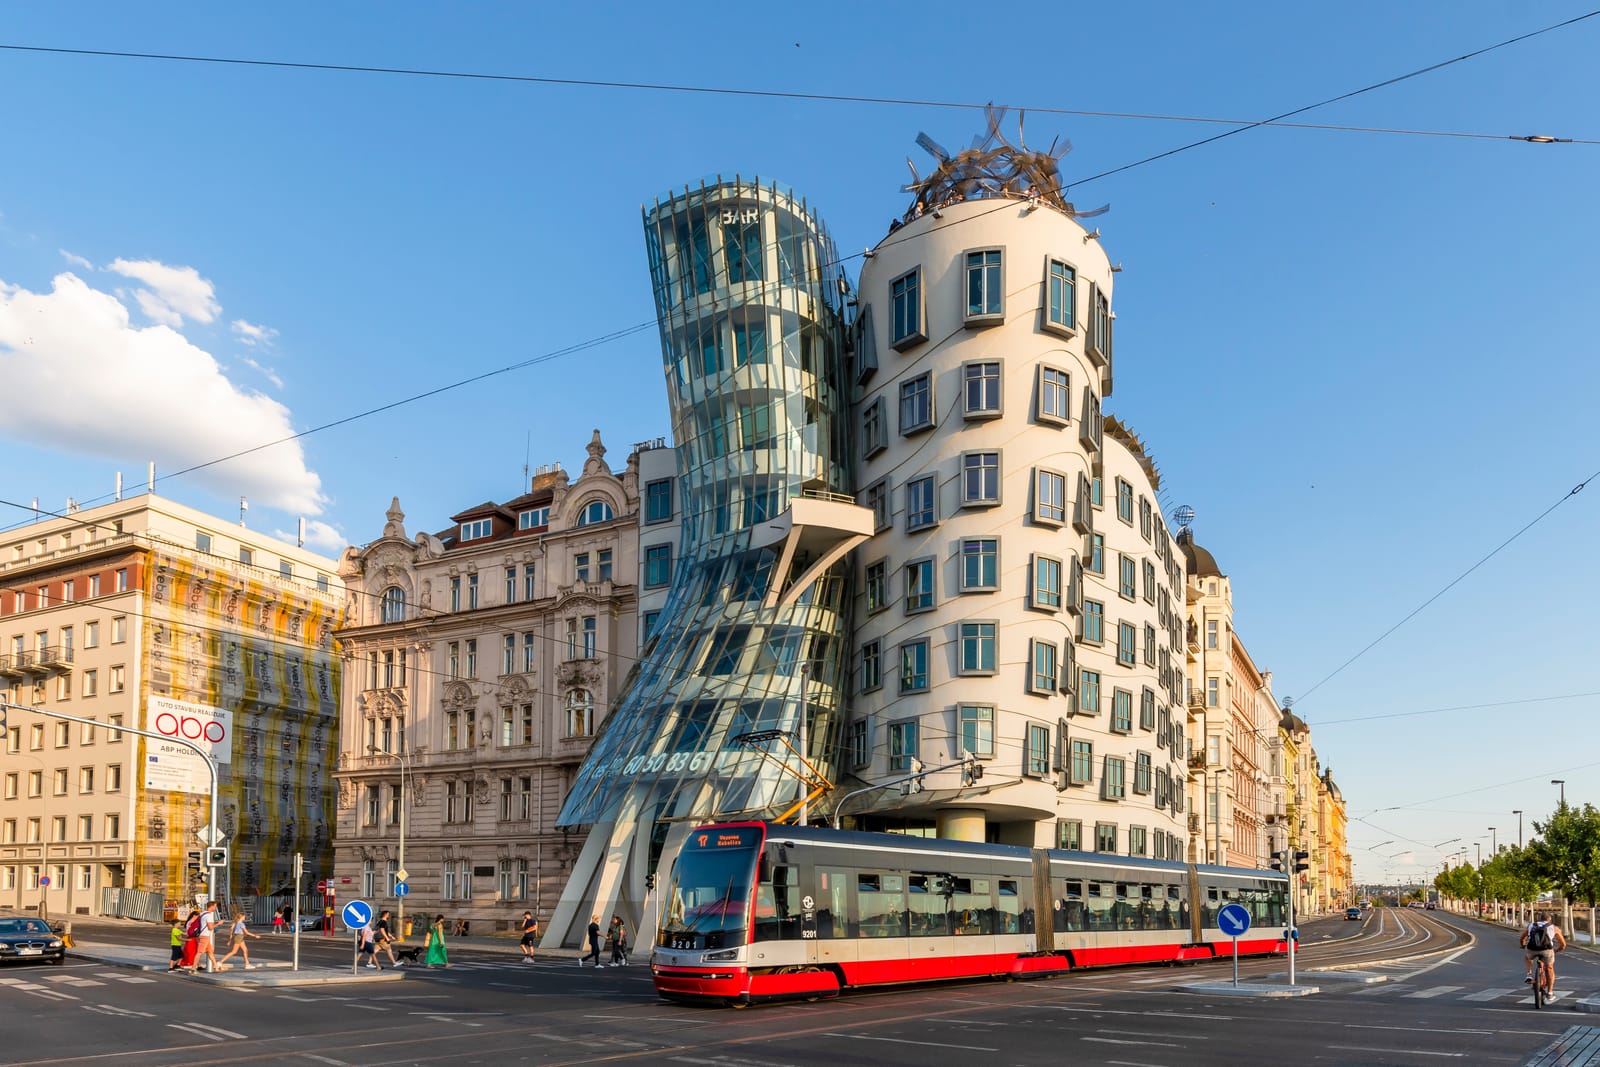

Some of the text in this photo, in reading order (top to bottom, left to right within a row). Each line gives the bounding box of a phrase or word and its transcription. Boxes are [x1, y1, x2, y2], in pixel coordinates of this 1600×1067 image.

[720, 208, 759, 225] BAR
[155, 565, 167, 605] weber
[160, 745, 175, 754] ABP
[623, 754, 644, 776] 60
[665, 752, 690, 772] 83
[802, 930, 817, 938] 9201
[672, 940, 697, 949] 9201
